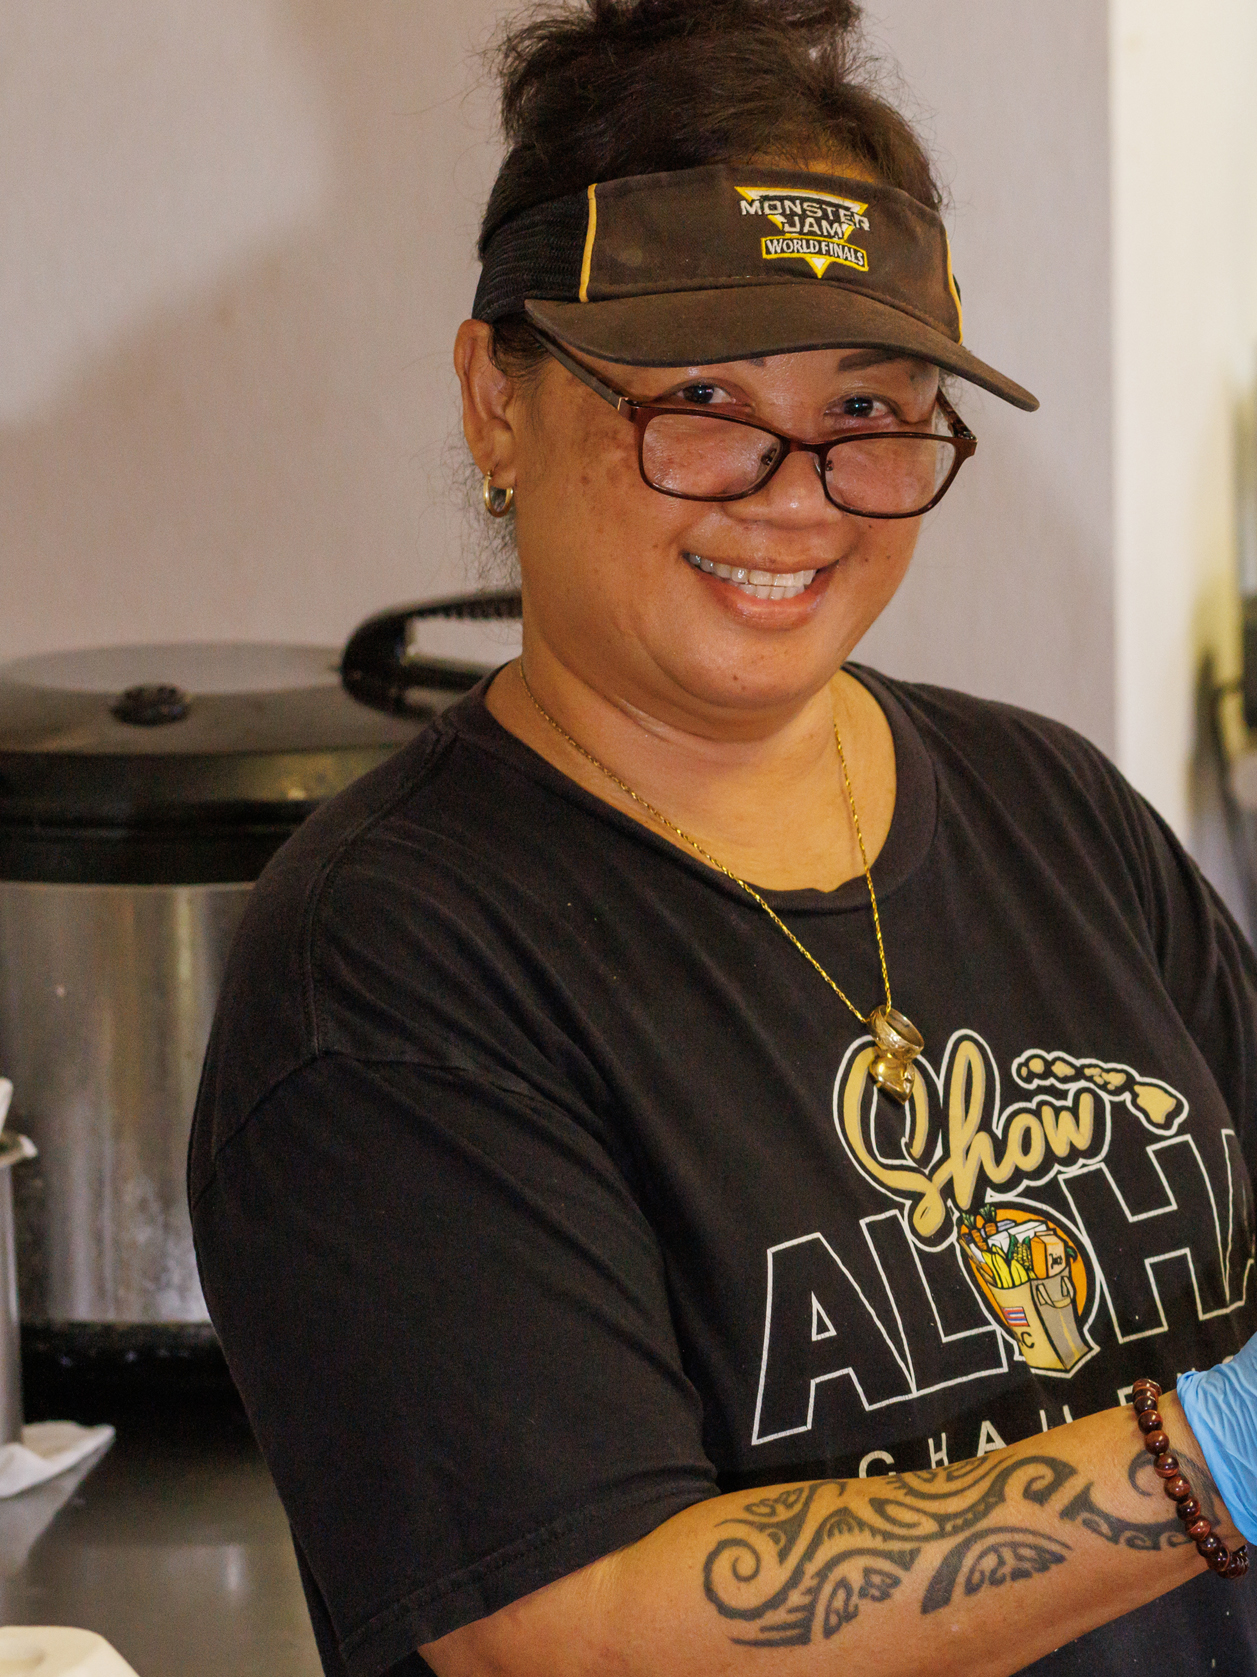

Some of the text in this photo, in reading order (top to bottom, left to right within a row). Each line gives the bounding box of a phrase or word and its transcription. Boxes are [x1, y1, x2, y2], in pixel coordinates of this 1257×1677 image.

[739, 200, 870, 231] MONSTER
[783, 216, 843, 239] JAM
[765, 239, 864, 266] WORLD FINALS
[842, 1040, 1095, 1237] Show
